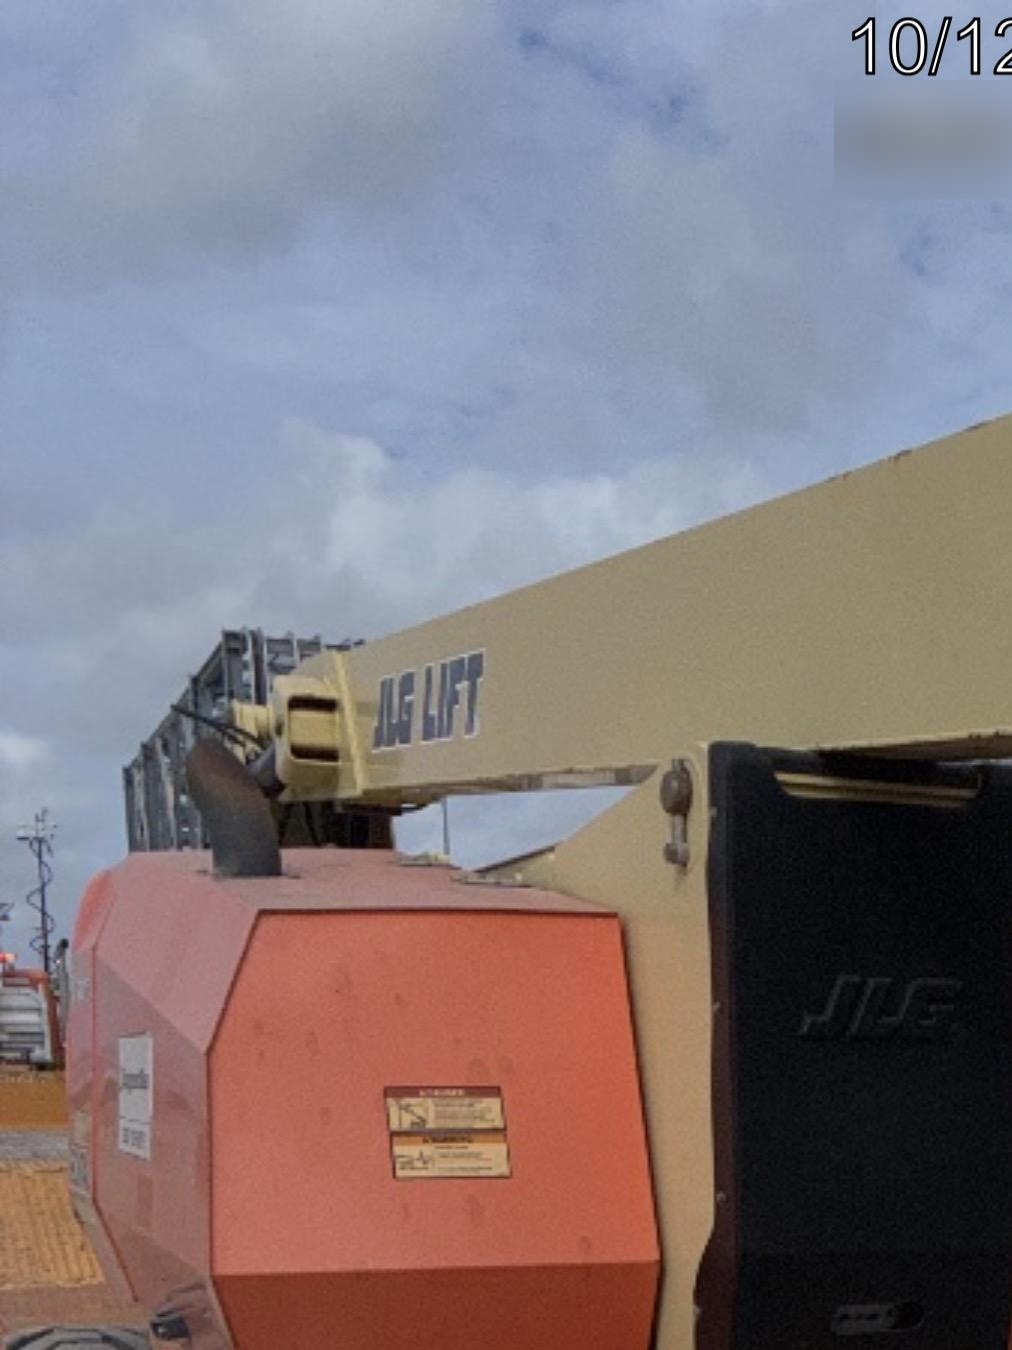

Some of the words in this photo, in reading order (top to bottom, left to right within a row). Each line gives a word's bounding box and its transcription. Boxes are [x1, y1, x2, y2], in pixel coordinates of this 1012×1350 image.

[372, 671, 415, 752] JLG
[420, 650, 485, 743] LIFT
[799, 974, 963, 1038] JLG
